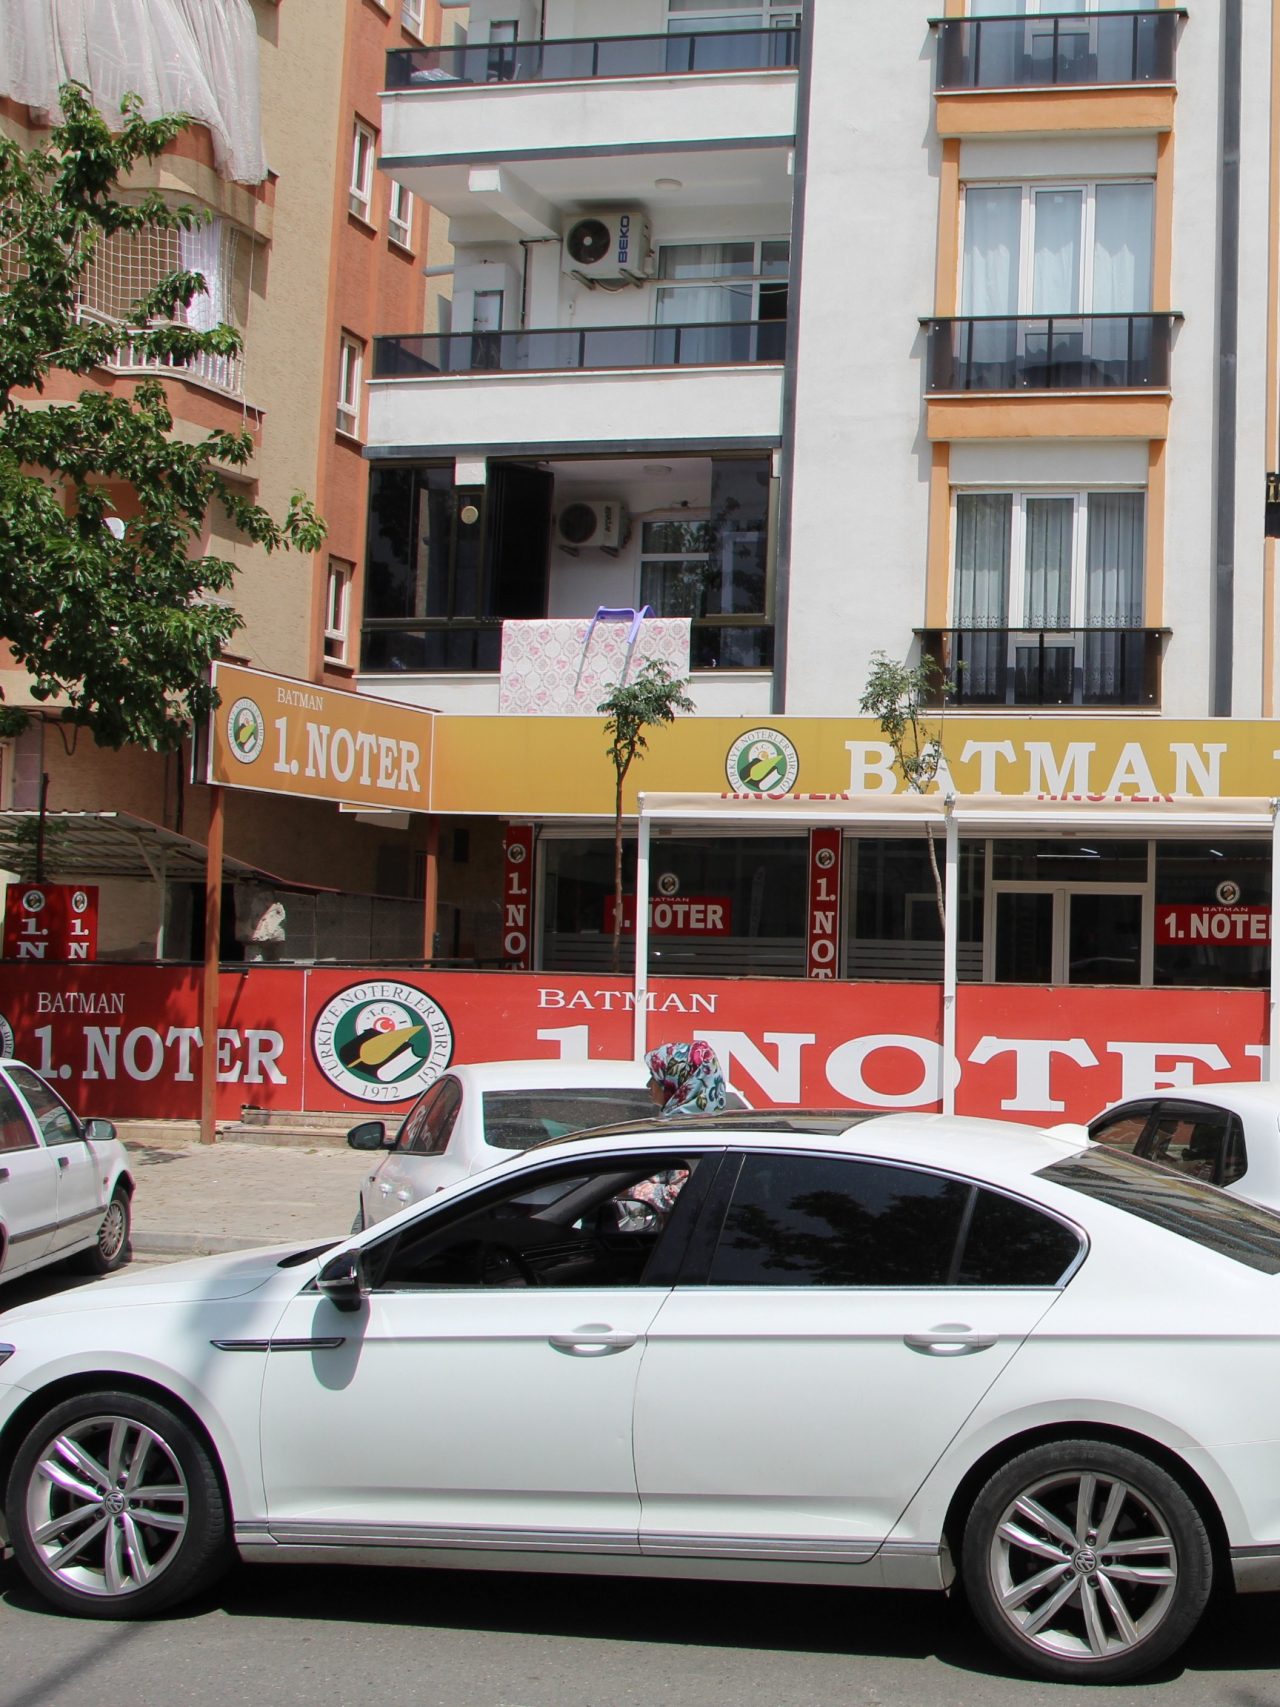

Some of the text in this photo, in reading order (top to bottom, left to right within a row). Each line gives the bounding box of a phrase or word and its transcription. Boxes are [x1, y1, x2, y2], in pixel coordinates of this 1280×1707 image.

[618, 215, 630, 263] BEKO
[277, 687, 324, 712] BATMAN
[273, 716, 299, 776] 1.
[305, 721, 421, 793] NOTER
[844, 740, 1228, 798] BATMAN
[508, 872, 528, 895] 1.
[816, 877, 836, 901] 1.
[1164, 913, 1185, 938] 1.
[37, 992, 126, 1014] BATMAN
[536, 988, 719, 1014] BATMAN
[316, 985, 451, 1087] TÜRKİYE NOTERLER BİRLİĞİ
[34, 1024, 288, 1085] 1. NOTER
[361, 1084, 401, 1100] 1972
